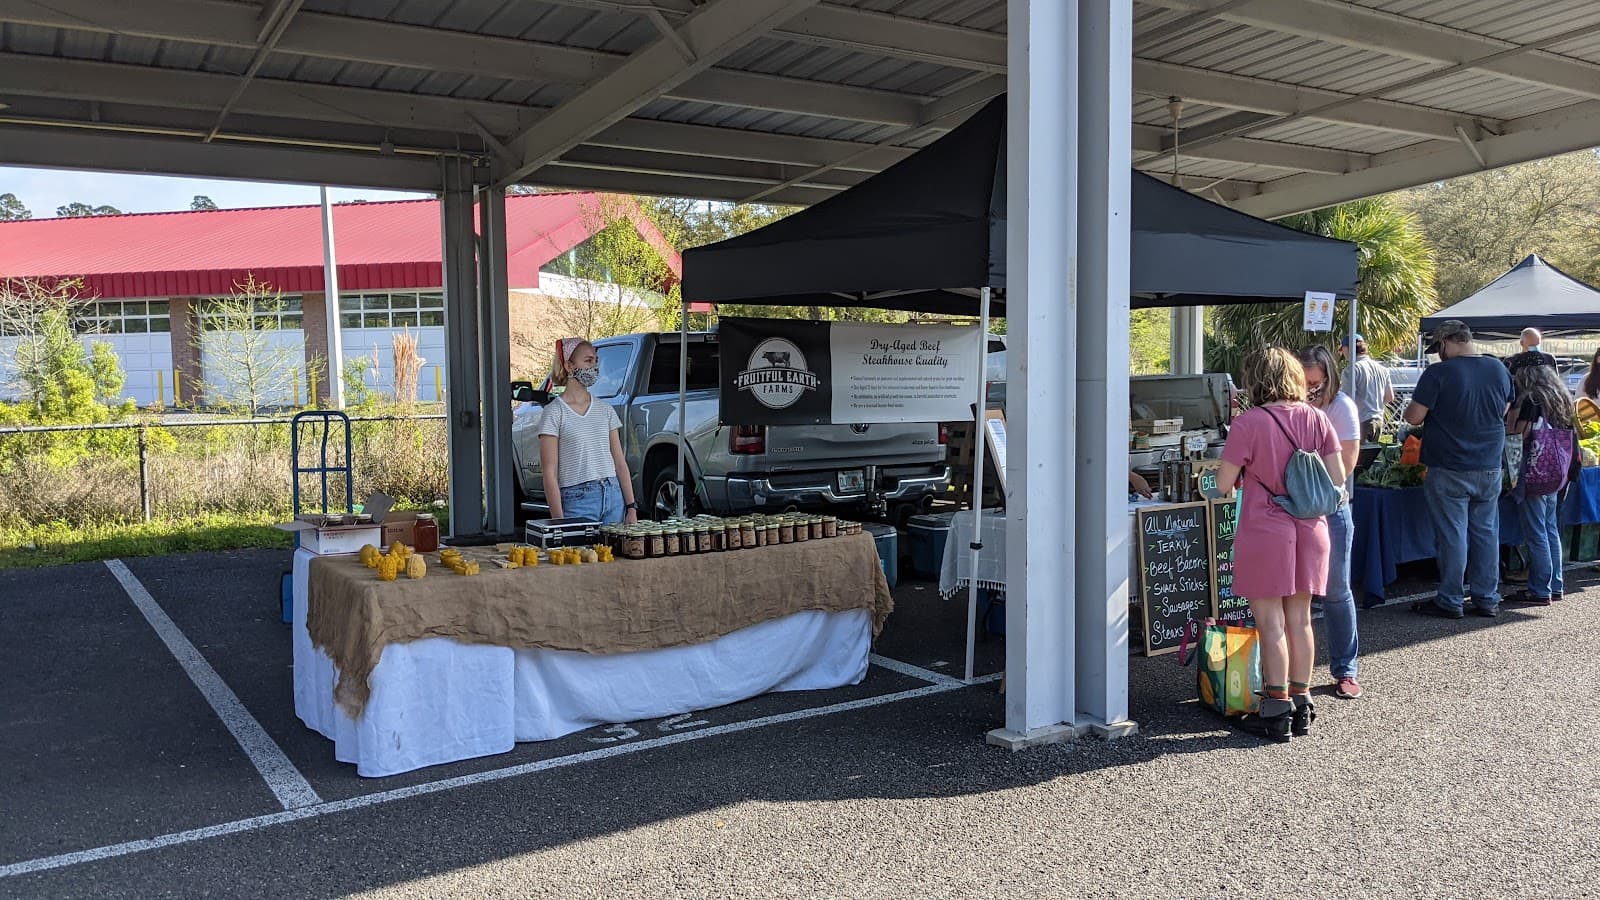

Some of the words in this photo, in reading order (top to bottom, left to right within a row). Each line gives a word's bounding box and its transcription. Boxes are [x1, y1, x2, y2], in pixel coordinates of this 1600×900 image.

[870, 338, 917, 354] Dry-Aged
[919, 340, 942, 354] Beef
[861, 354, 913, 366] Steakhouse
[915, 355, 948, 368] Quality
[738, 370, 784, 387] FRUITFUL
[786, 371, 817, 387] EARTH
[763, 384, 793, 394] FARMS
[1164, 511, 1200, 530] Natural
[1149, 556, 1174, 580] Beef
[1175, 555, 1206, 573] Bacon
[1162, 596, 1199, 618] Sausages
[1222, 597, 1249, 609] DRY-AGE
